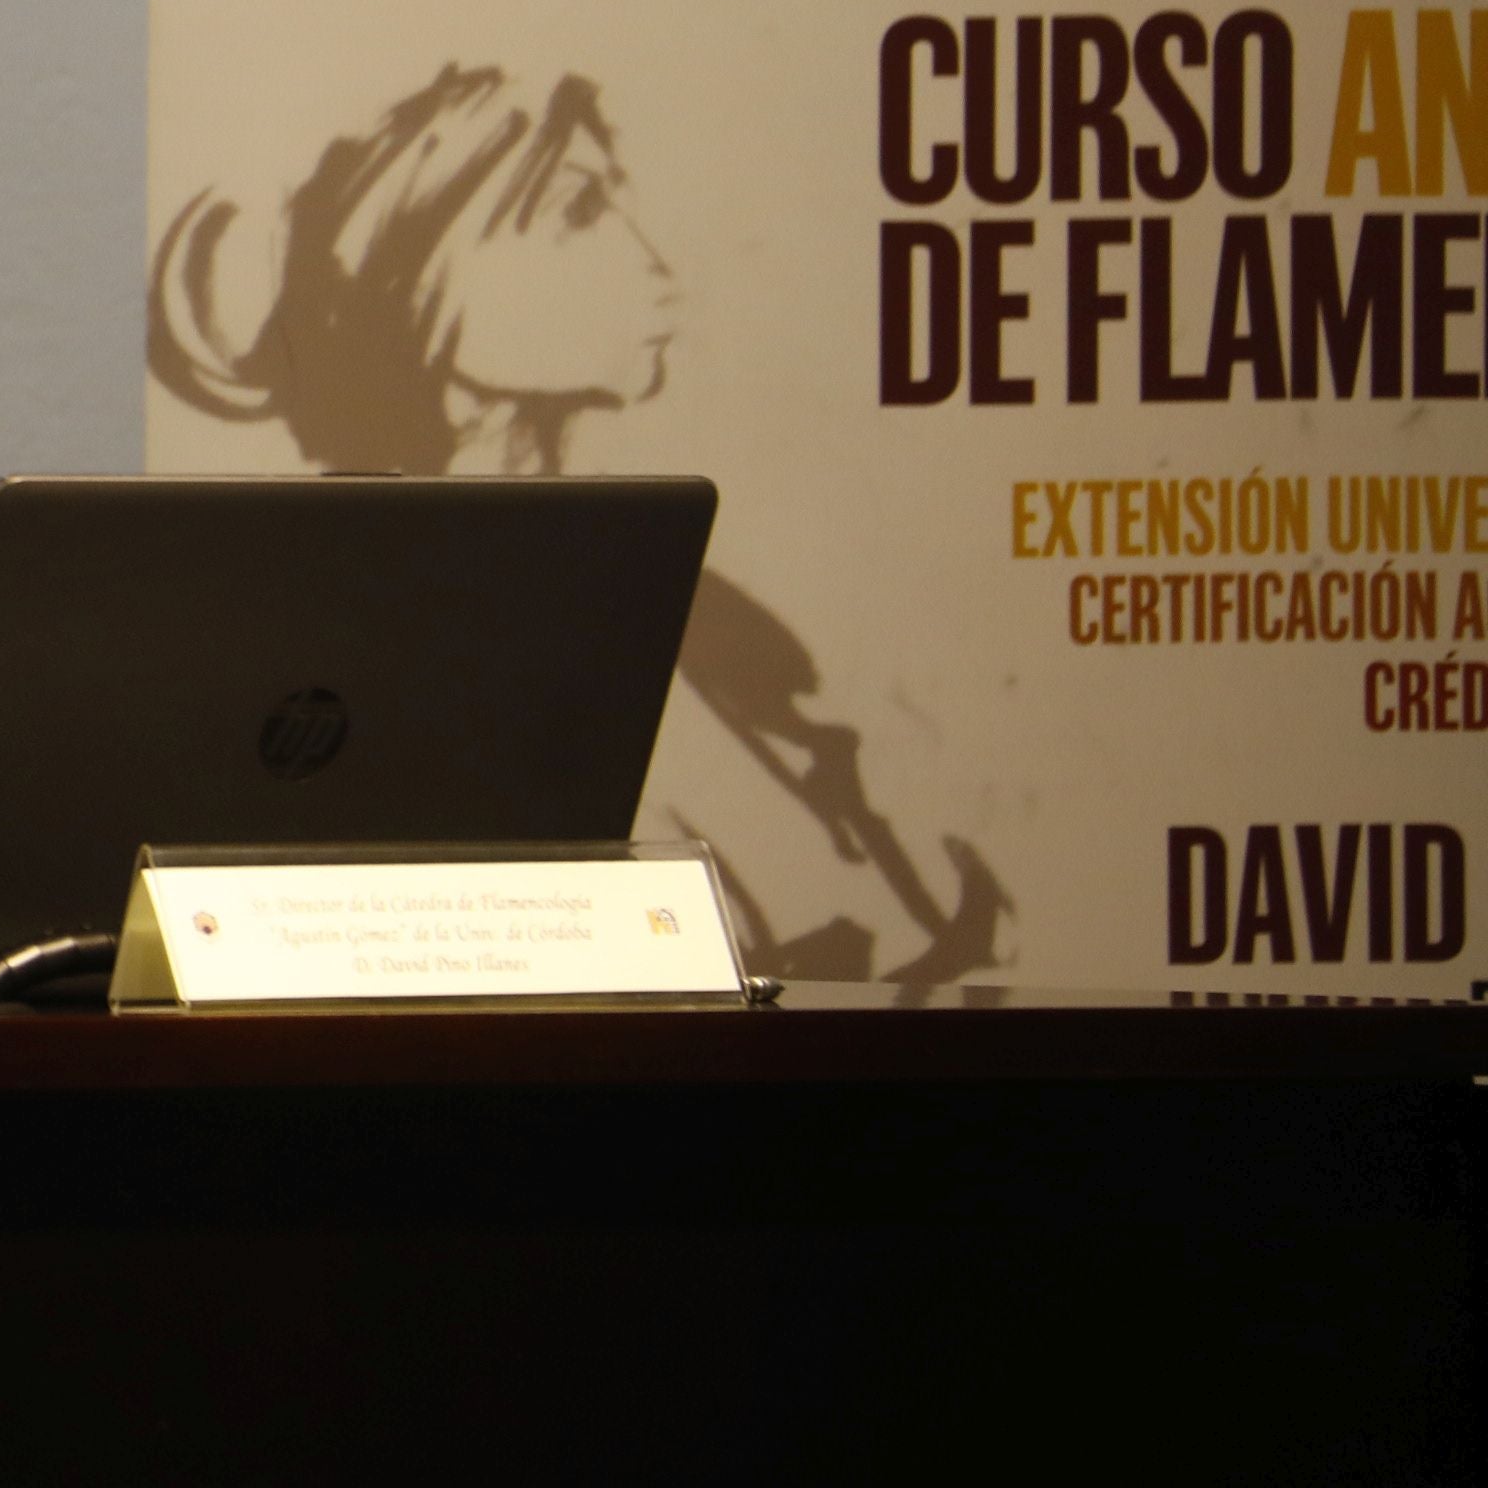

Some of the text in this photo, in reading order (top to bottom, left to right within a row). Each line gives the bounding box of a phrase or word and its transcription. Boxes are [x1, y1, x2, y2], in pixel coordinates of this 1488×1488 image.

[878, 8, 1294, 206] CURSO
[879, 213, 1488, 407] DE FLAME
[1011, 467, 1309, 559] EXTENSIÓN
[1069, 559, 1437, 646] CERTIFICACIÓN
[1364, 650, 1488, 733] CRÉD
[1167, 823, 1467, 965] DAVID
